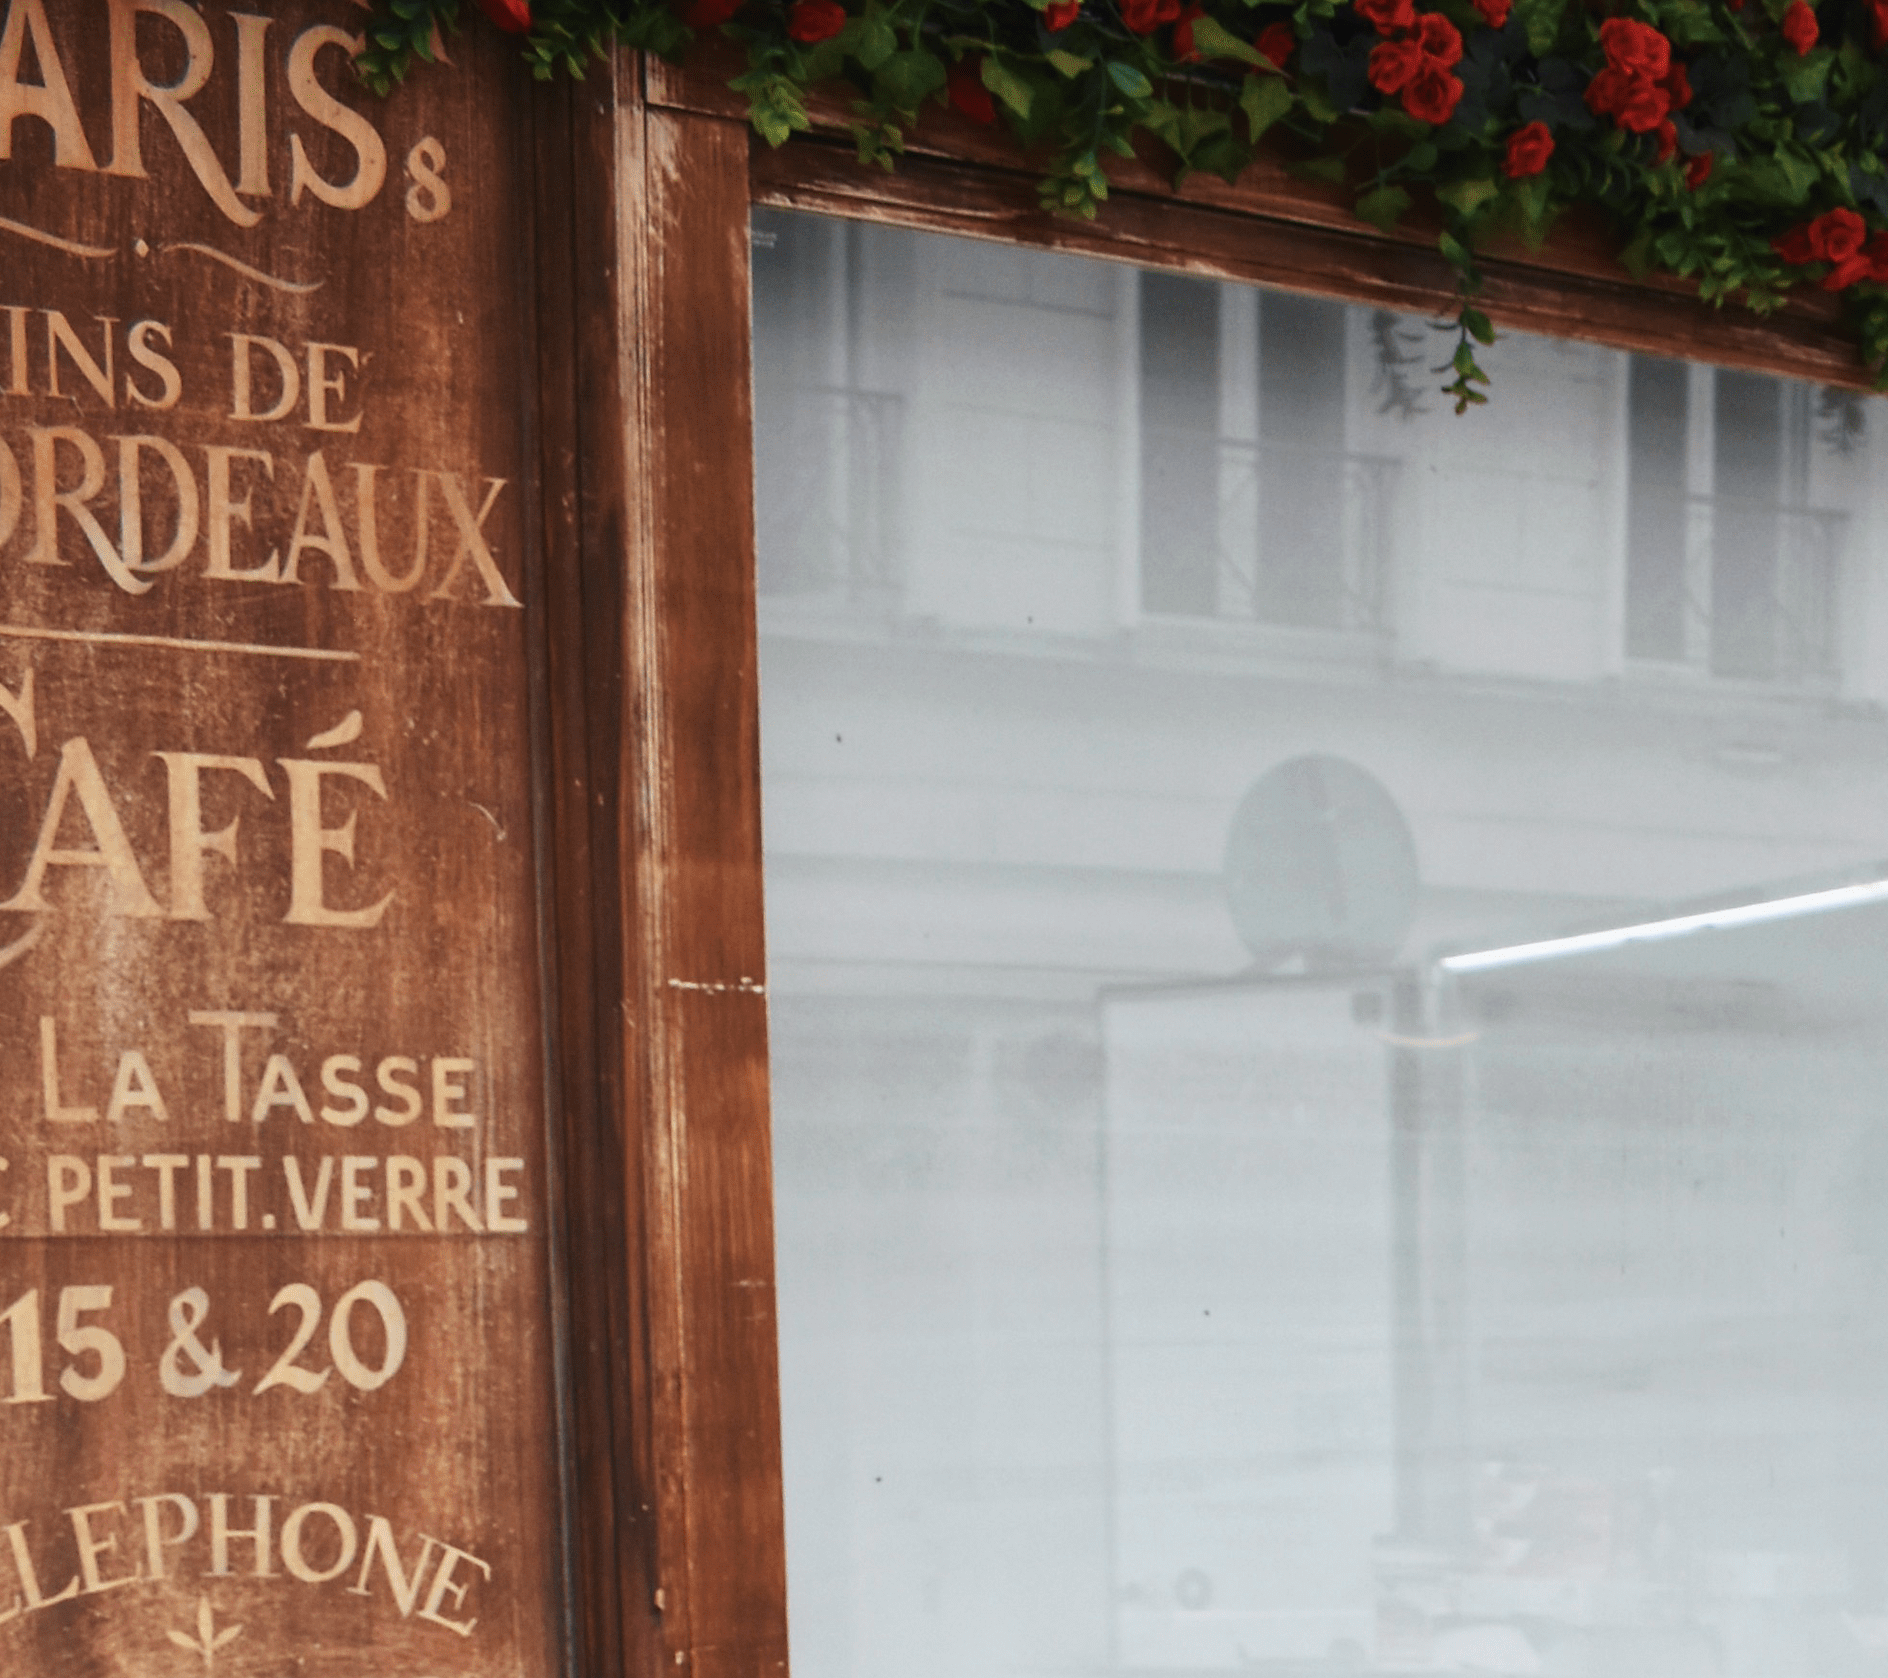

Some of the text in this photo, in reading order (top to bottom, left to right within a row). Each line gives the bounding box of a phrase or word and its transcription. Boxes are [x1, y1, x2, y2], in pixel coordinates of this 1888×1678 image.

[225, 331, 363, 434] DE
[0, 424, 525, 609] RDEAUX
[0, 664, 396, 968] AFÉ
[40, 1009, 477, 1128] LA TASSE
[0, 1278, 408, 1403] 15 & 20
[0, 1492, 492, 1638] LEPHONE
